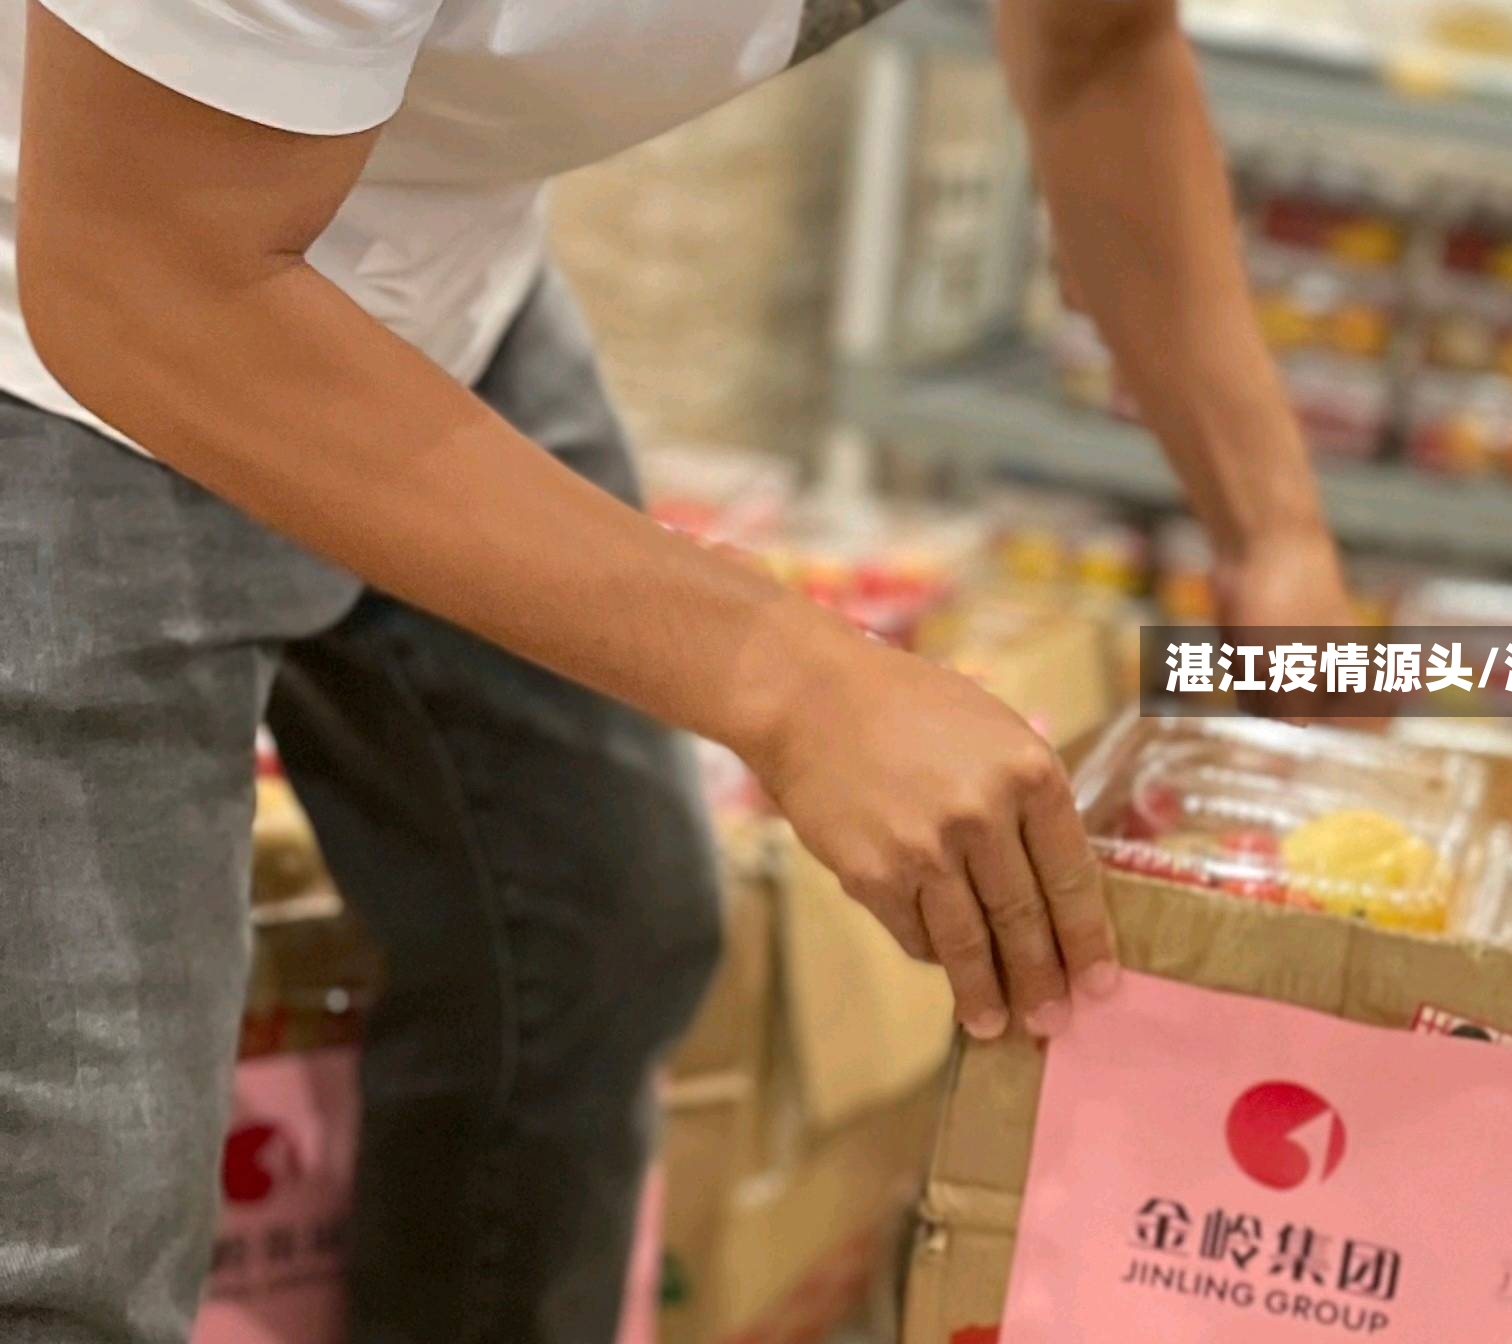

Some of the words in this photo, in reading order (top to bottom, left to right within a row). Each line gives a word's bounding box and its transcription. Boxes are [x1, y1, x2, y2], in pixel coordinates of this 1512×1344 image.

[1130, 1197, 1401, 1301] 金岭集团
[1121, 1259, 1255, 1308] JINLING
[1264, 1288, 1390, 1335] GROUP
